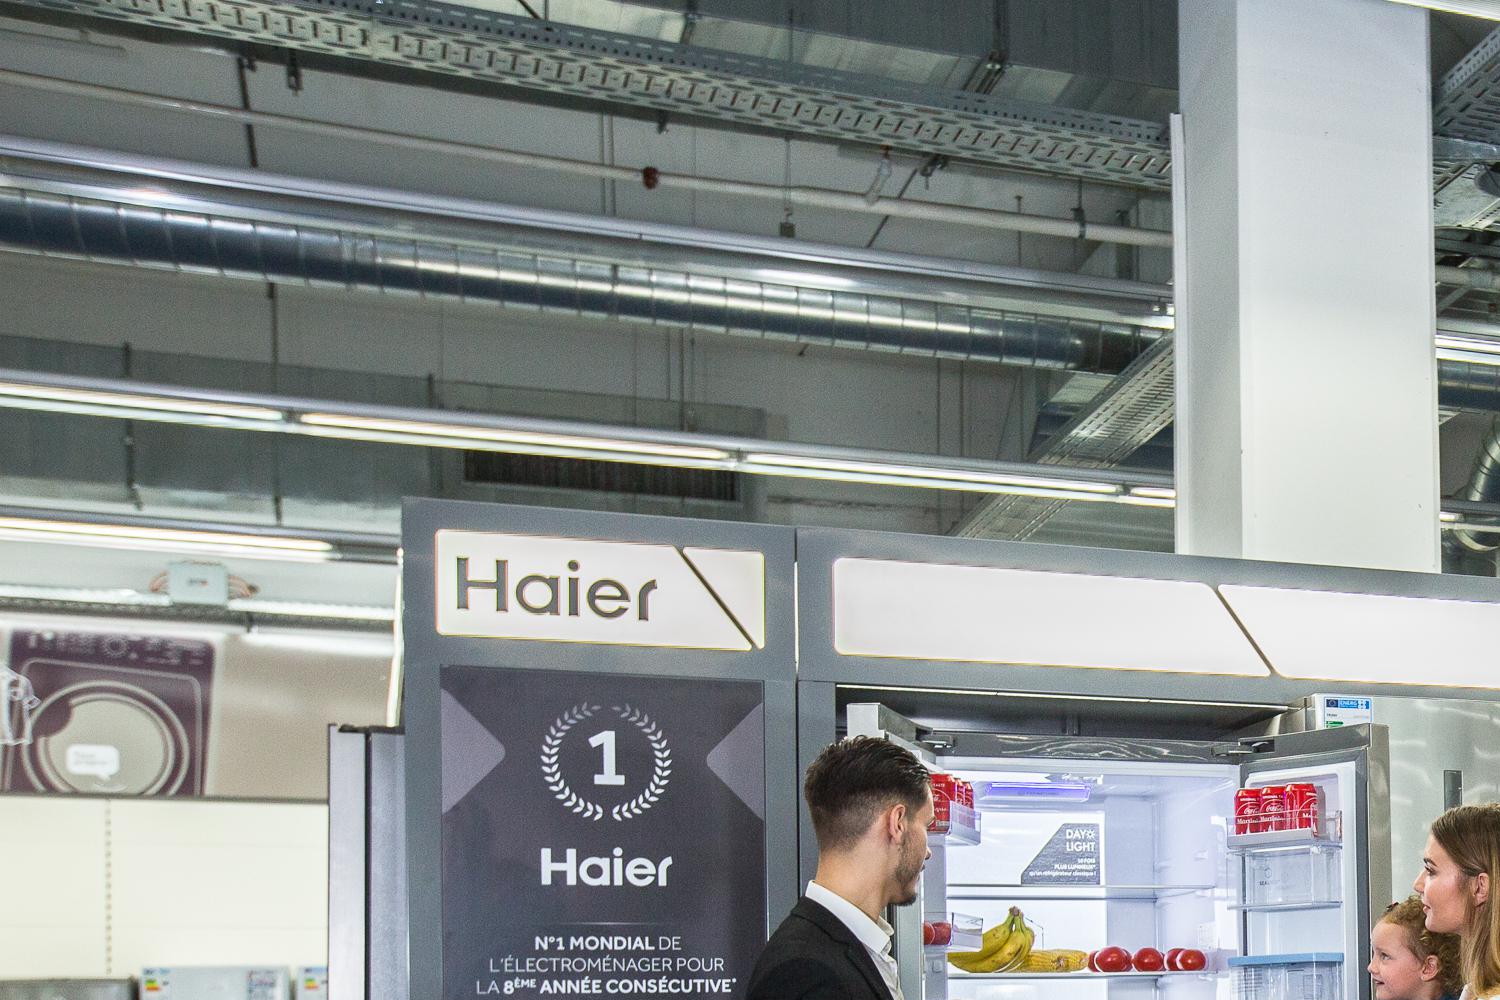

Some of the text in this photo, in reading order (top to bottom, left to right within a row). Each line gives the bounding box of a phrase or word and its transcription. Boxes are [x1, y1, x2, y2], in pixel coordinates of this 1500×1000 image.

[456, 556, 658, 621] Haier
[588, 730, 625, 785] 1
[1066, 829, 1086, 839] DAY
[1066, 842, 1095, 851] LIGHT
[541, 847, 672, 886] Haier
[535, 936, 681, 950] N°1 MONDIAL DE
[490, 954, 724, 973] L'ÉLECTROMÉNAGER POUR
[476, 980, 500, 995] LA
[540, 976, 602, 994] ANNÉE
